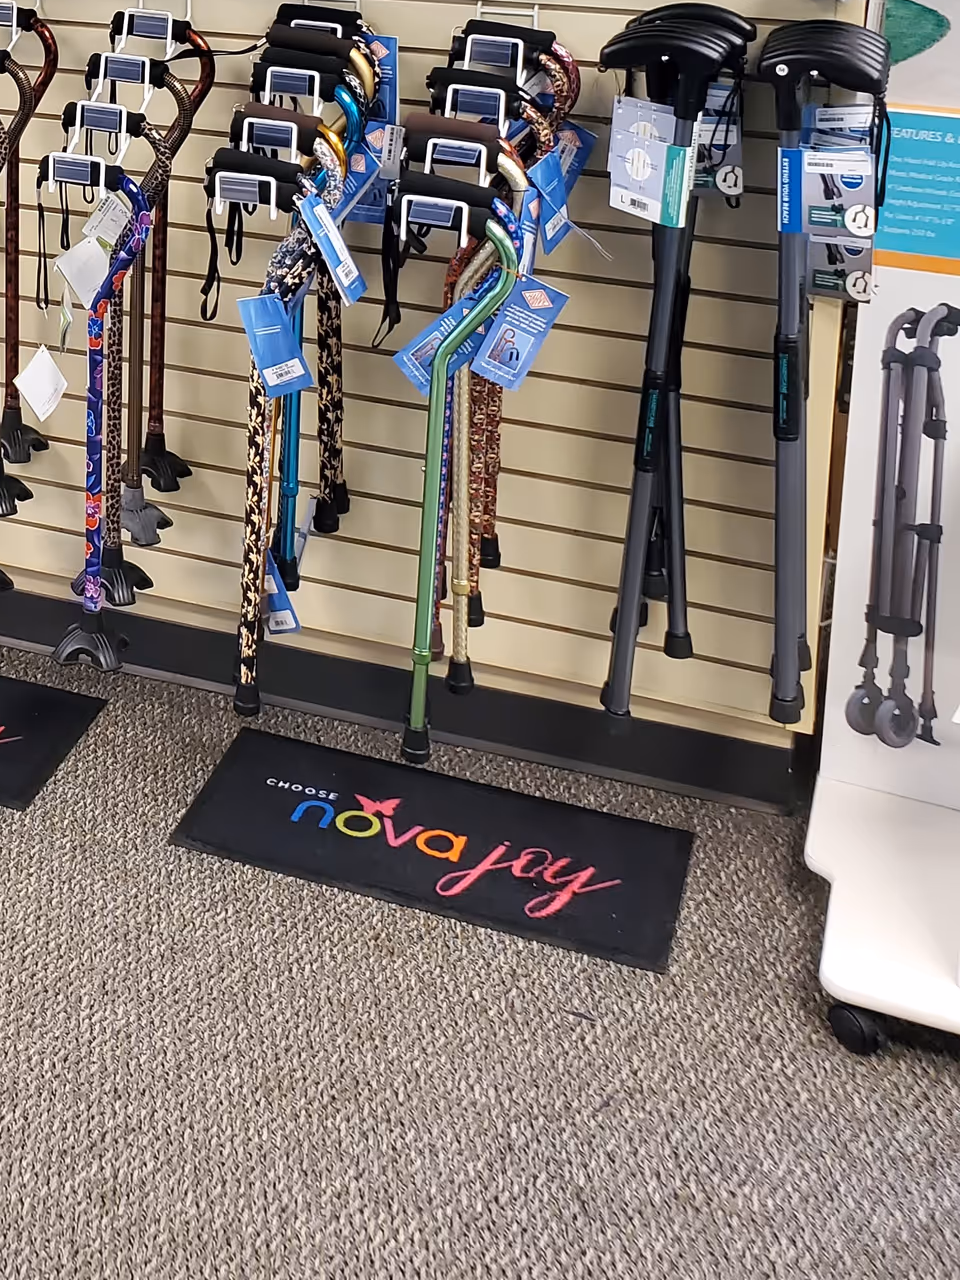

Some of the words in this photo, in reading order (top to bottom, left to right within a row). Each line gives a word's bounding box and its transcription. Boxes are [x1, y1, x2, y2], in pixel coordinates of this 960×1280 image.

[944, 132, 956, 144] &
[265, 776, 339, 801] CHOOSE
[290, 799, 469, 864] nova
[434, 840, 623, 919] joy
